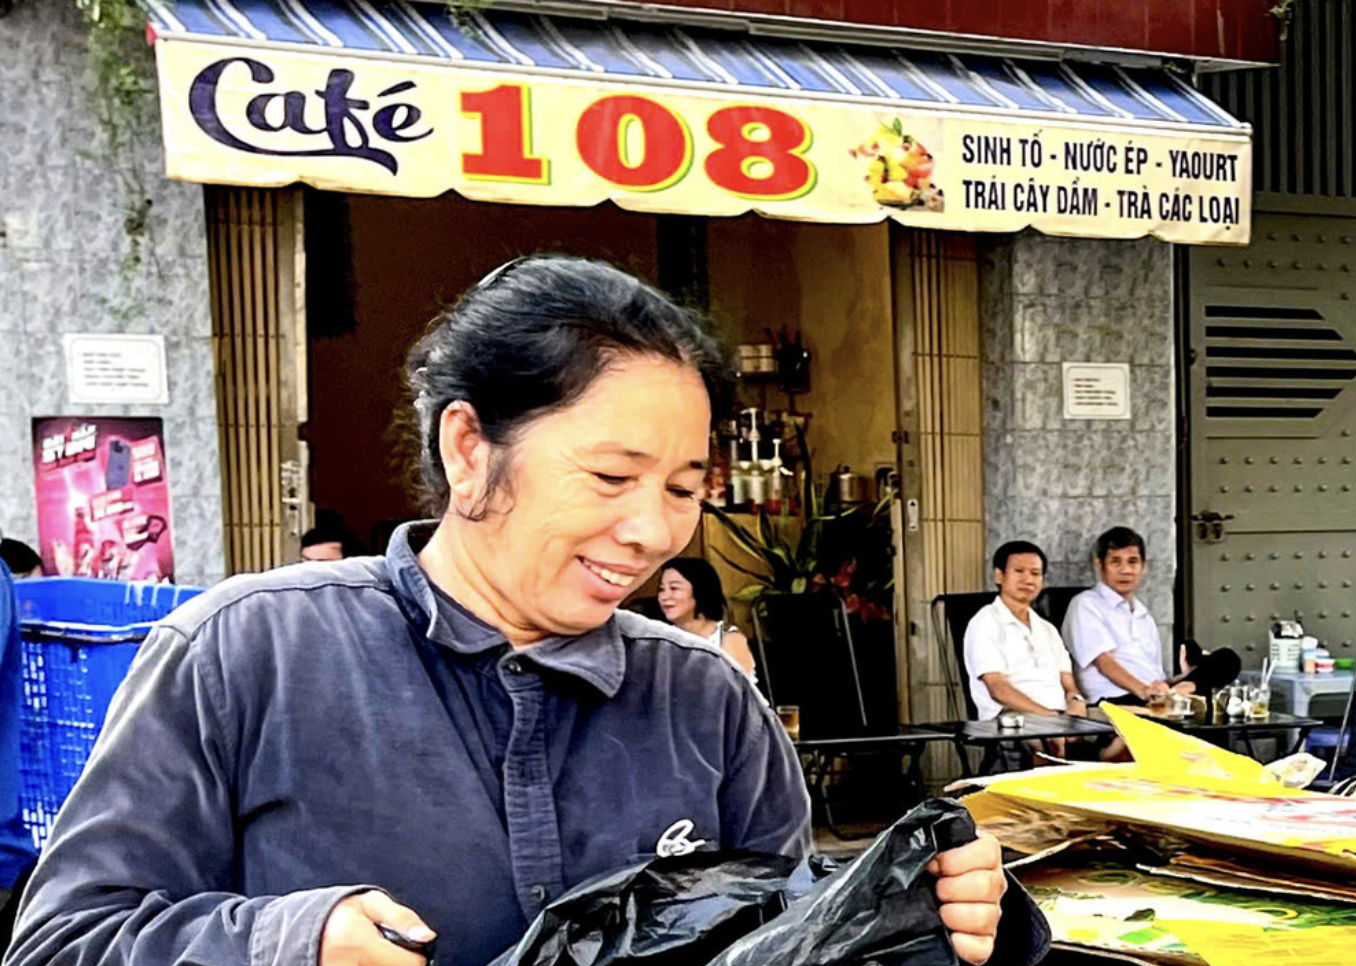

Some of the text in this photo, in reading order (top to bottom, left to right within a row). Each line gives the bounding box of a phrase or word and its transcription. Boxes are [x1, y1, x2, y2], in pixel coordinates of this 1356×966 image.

[188, 57, 816, 201] Café 108
[962, 134, 1012, 165] SINH
[1018, 129, 1044, 168] TỐ
[1064, 138, 1118, 172] NƯỚC
[1125, 139, 1148, 175] ÉP
[1169, 149, 1238, 182] YAOURT
[962, 176, 1006, 211] TRÁI
[1013, 177, 1050, 213] CÂY
[1116, 184, 1153, 219] TRÀ
[1158, 190, 1193, 222] CÁC
[1198, 197, 1240, 231] LOẠI
